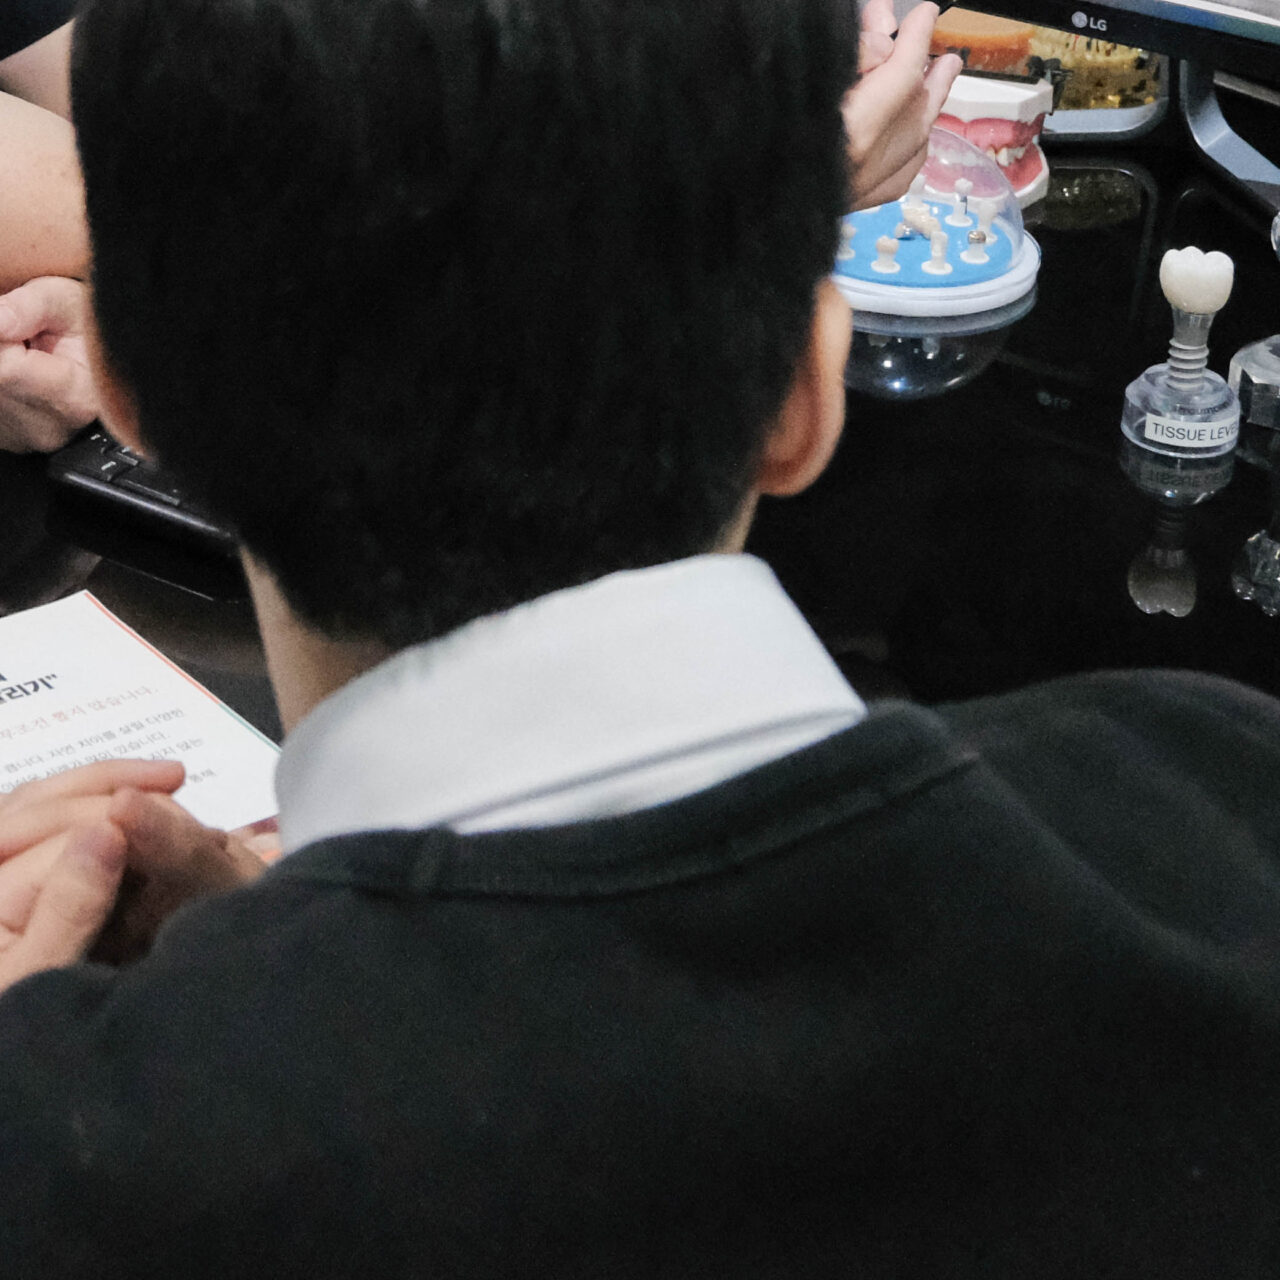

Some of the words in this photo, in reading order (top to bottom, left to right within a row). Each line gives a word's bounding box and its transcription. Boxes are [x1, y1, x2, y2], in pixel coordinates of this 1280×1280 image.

[1090, 17, 1107, 31] LG
[1153, 422, 1207, 441] TISSUE
[1210, 422, 1238, 440] LEVE
